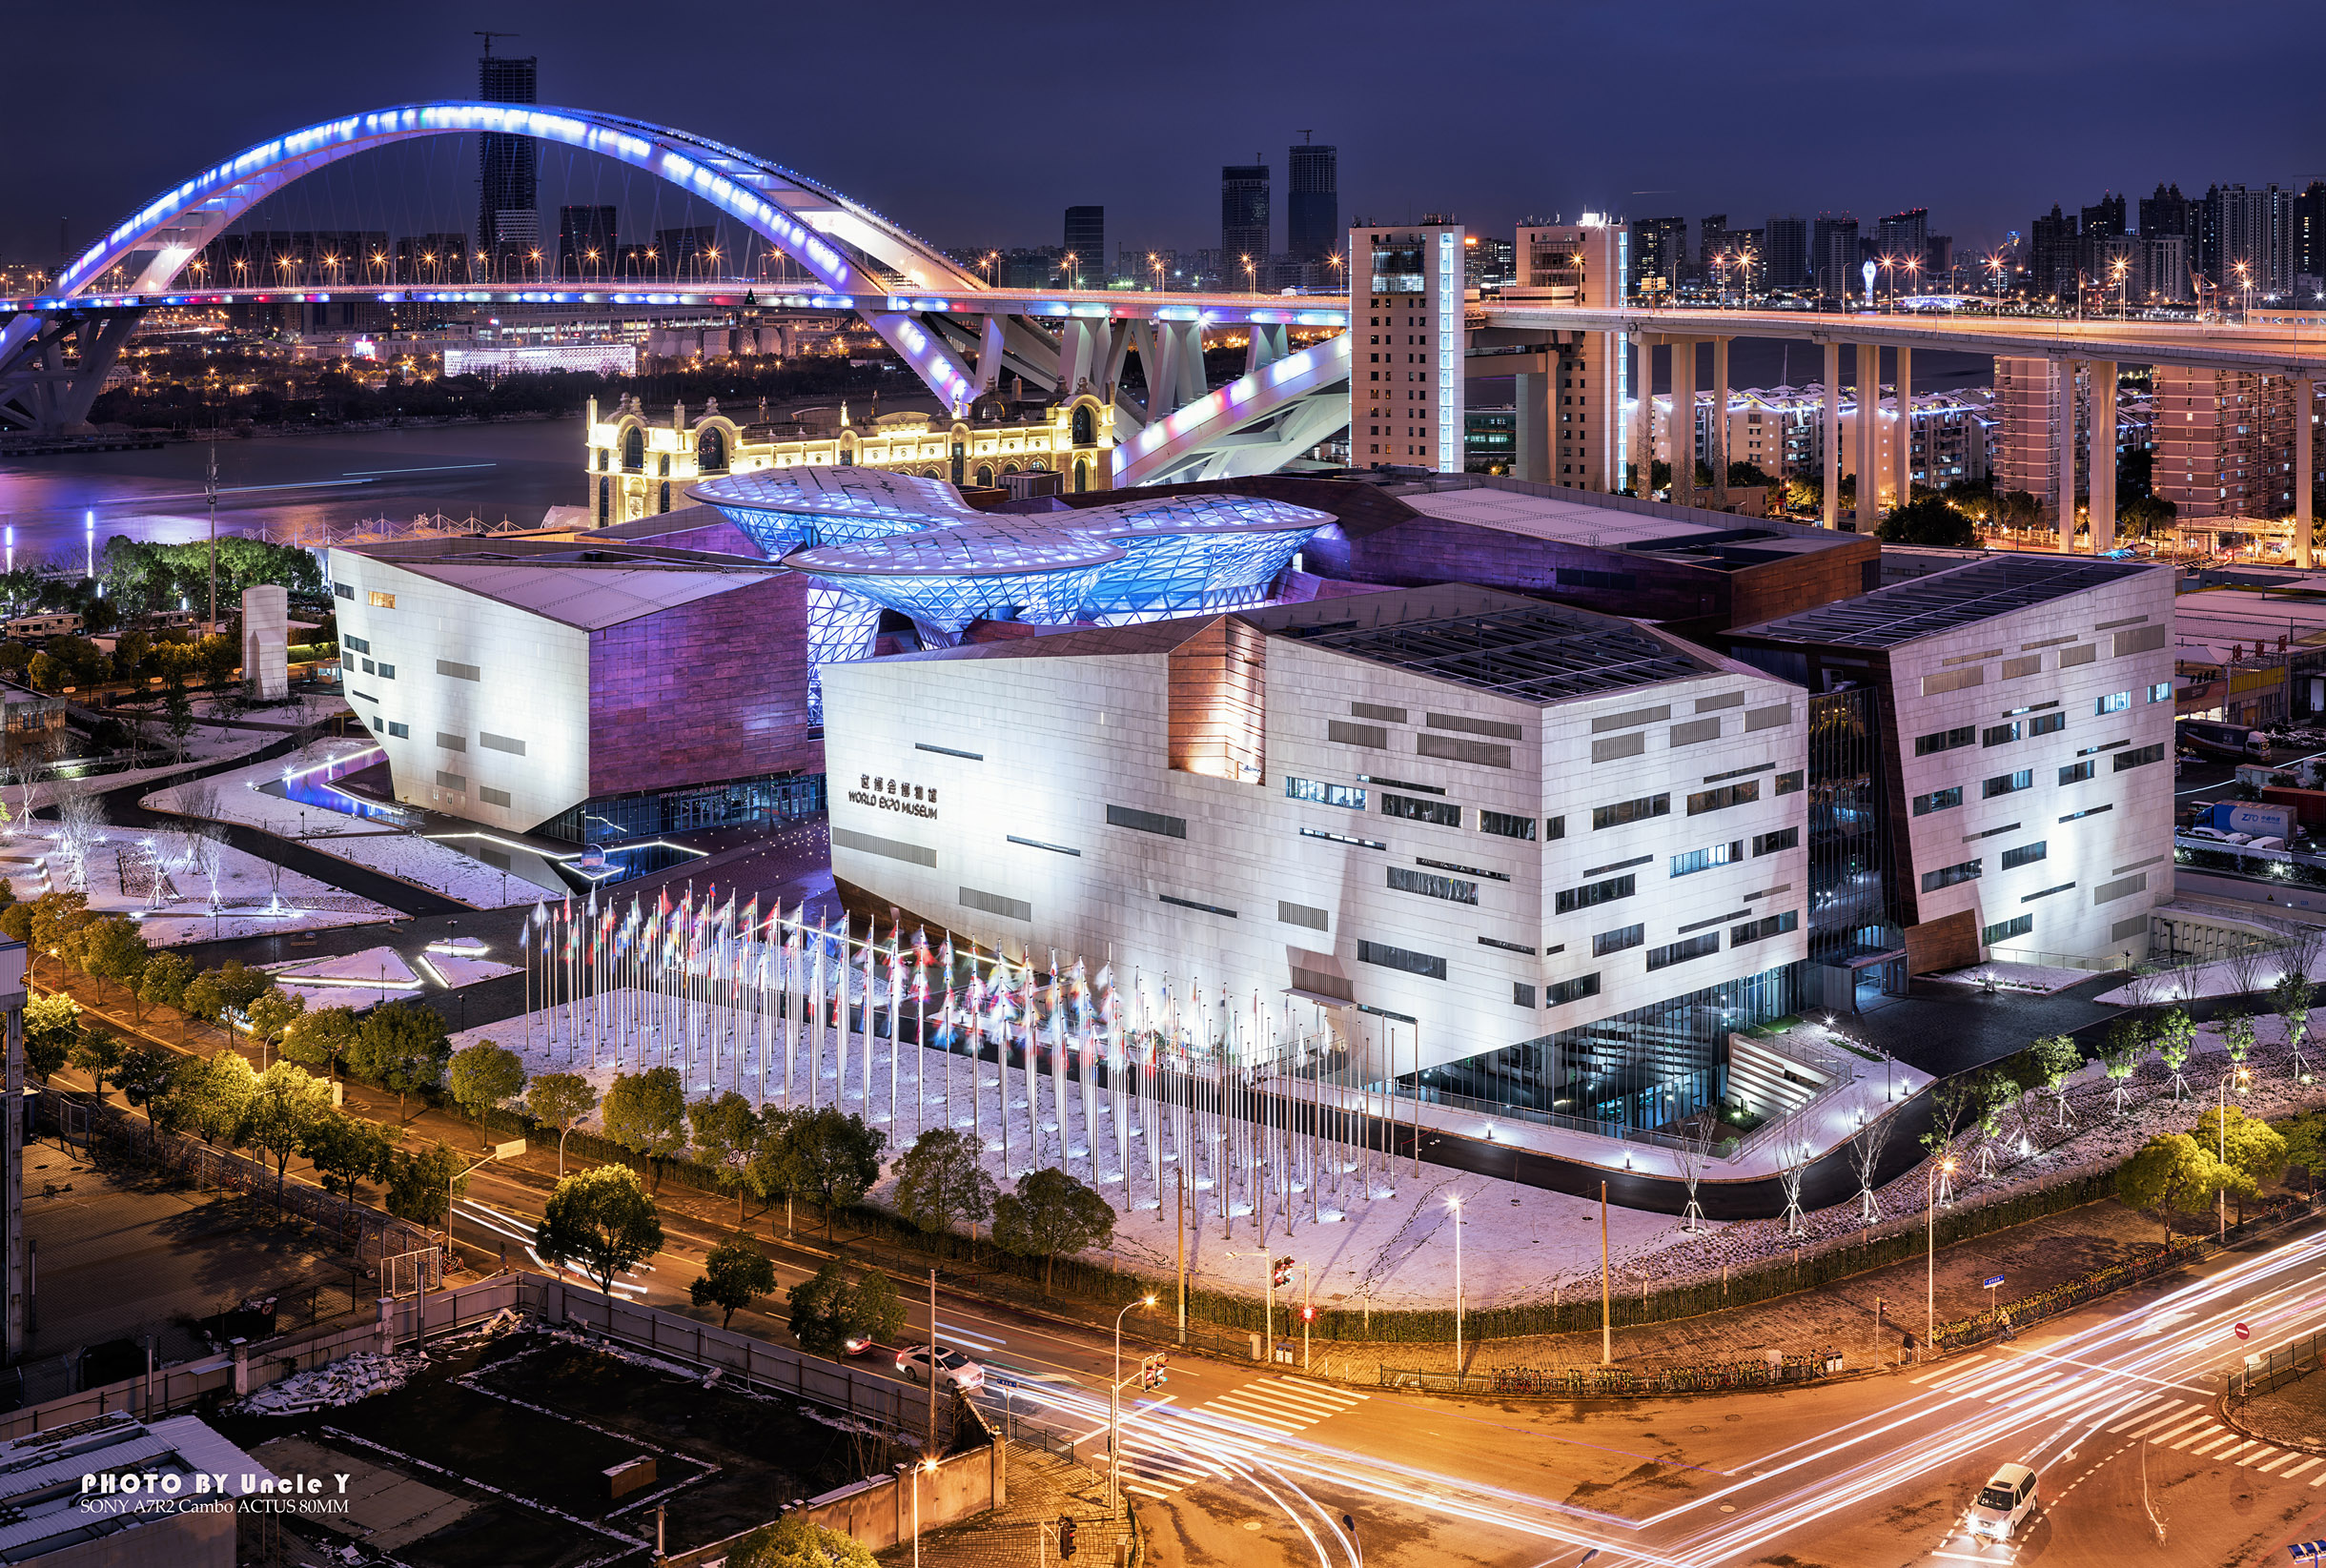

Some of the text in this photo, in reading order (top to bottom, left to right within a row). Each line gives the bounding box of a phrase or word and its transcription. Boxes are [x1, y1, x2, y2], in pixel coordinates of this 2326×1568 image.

[860, 773, 938, 804] 世博会博物馆
[847, 790, 938, 820] WORLD EXPO MUSEUM
[2241, 813, 2259, 823] ZTO
